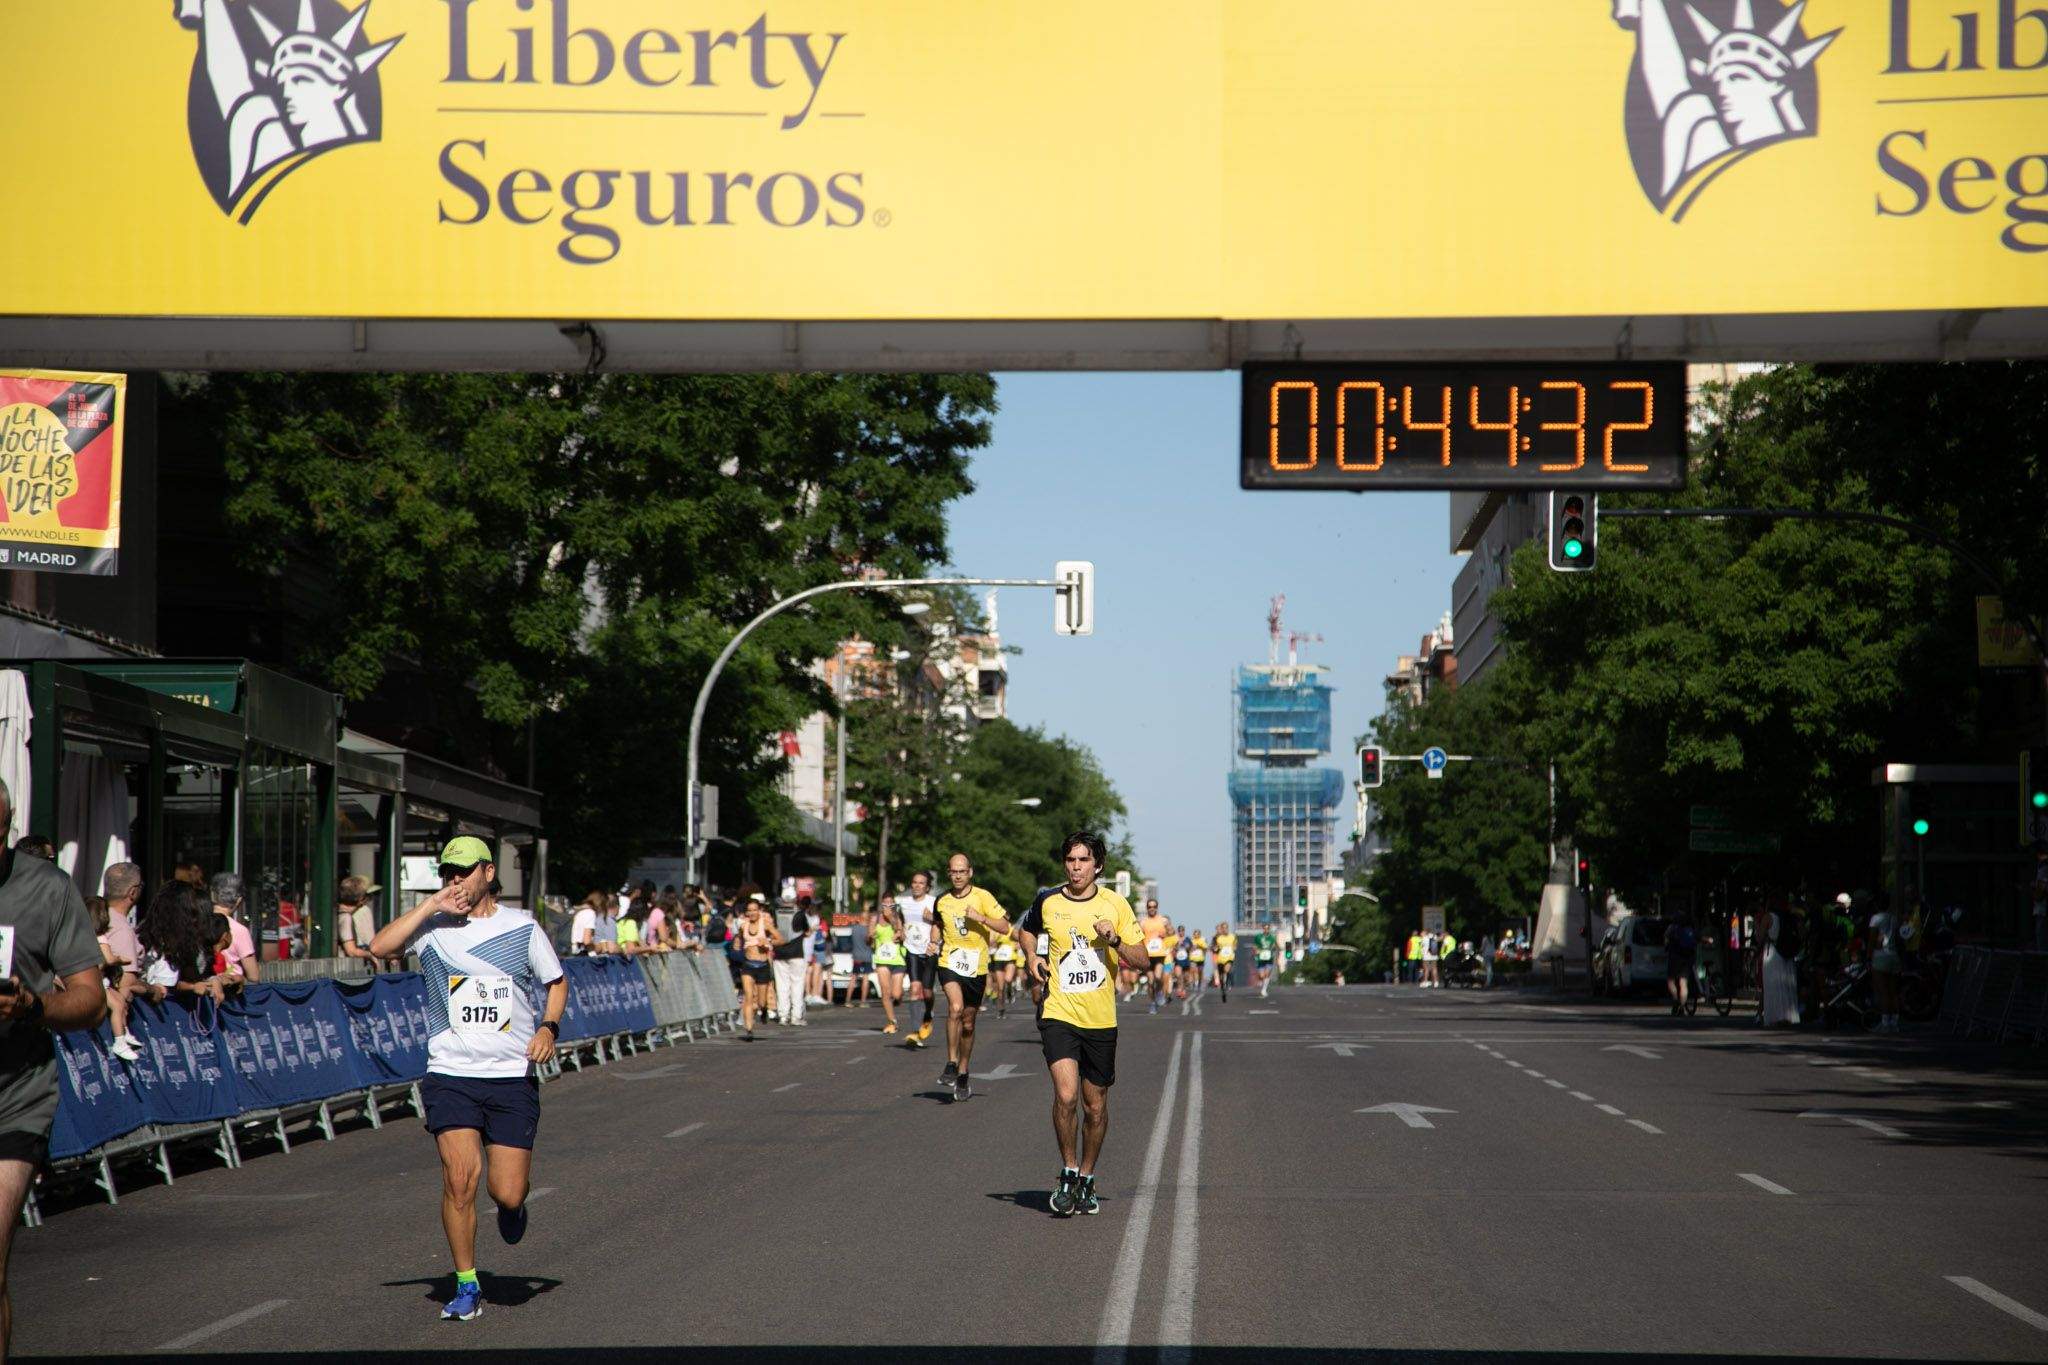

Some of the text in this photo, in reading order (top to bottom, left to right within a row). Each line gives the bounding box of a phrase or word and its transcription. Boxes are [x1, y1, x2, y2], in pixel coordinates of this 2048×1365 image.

[440, 0, 848, 131] Liberty
[12, 406, 37, 426] LA
[1270, 380, 1655, 472] 00:44:32
[0, 453, 72, 481] DE LAS
[6, 476, 73, 515] IDEAS
[17, 550, 77, 566] MADRID
[1068, 970, 1097, 985] 2678
[462, 1006, 498, 1023] 3175
